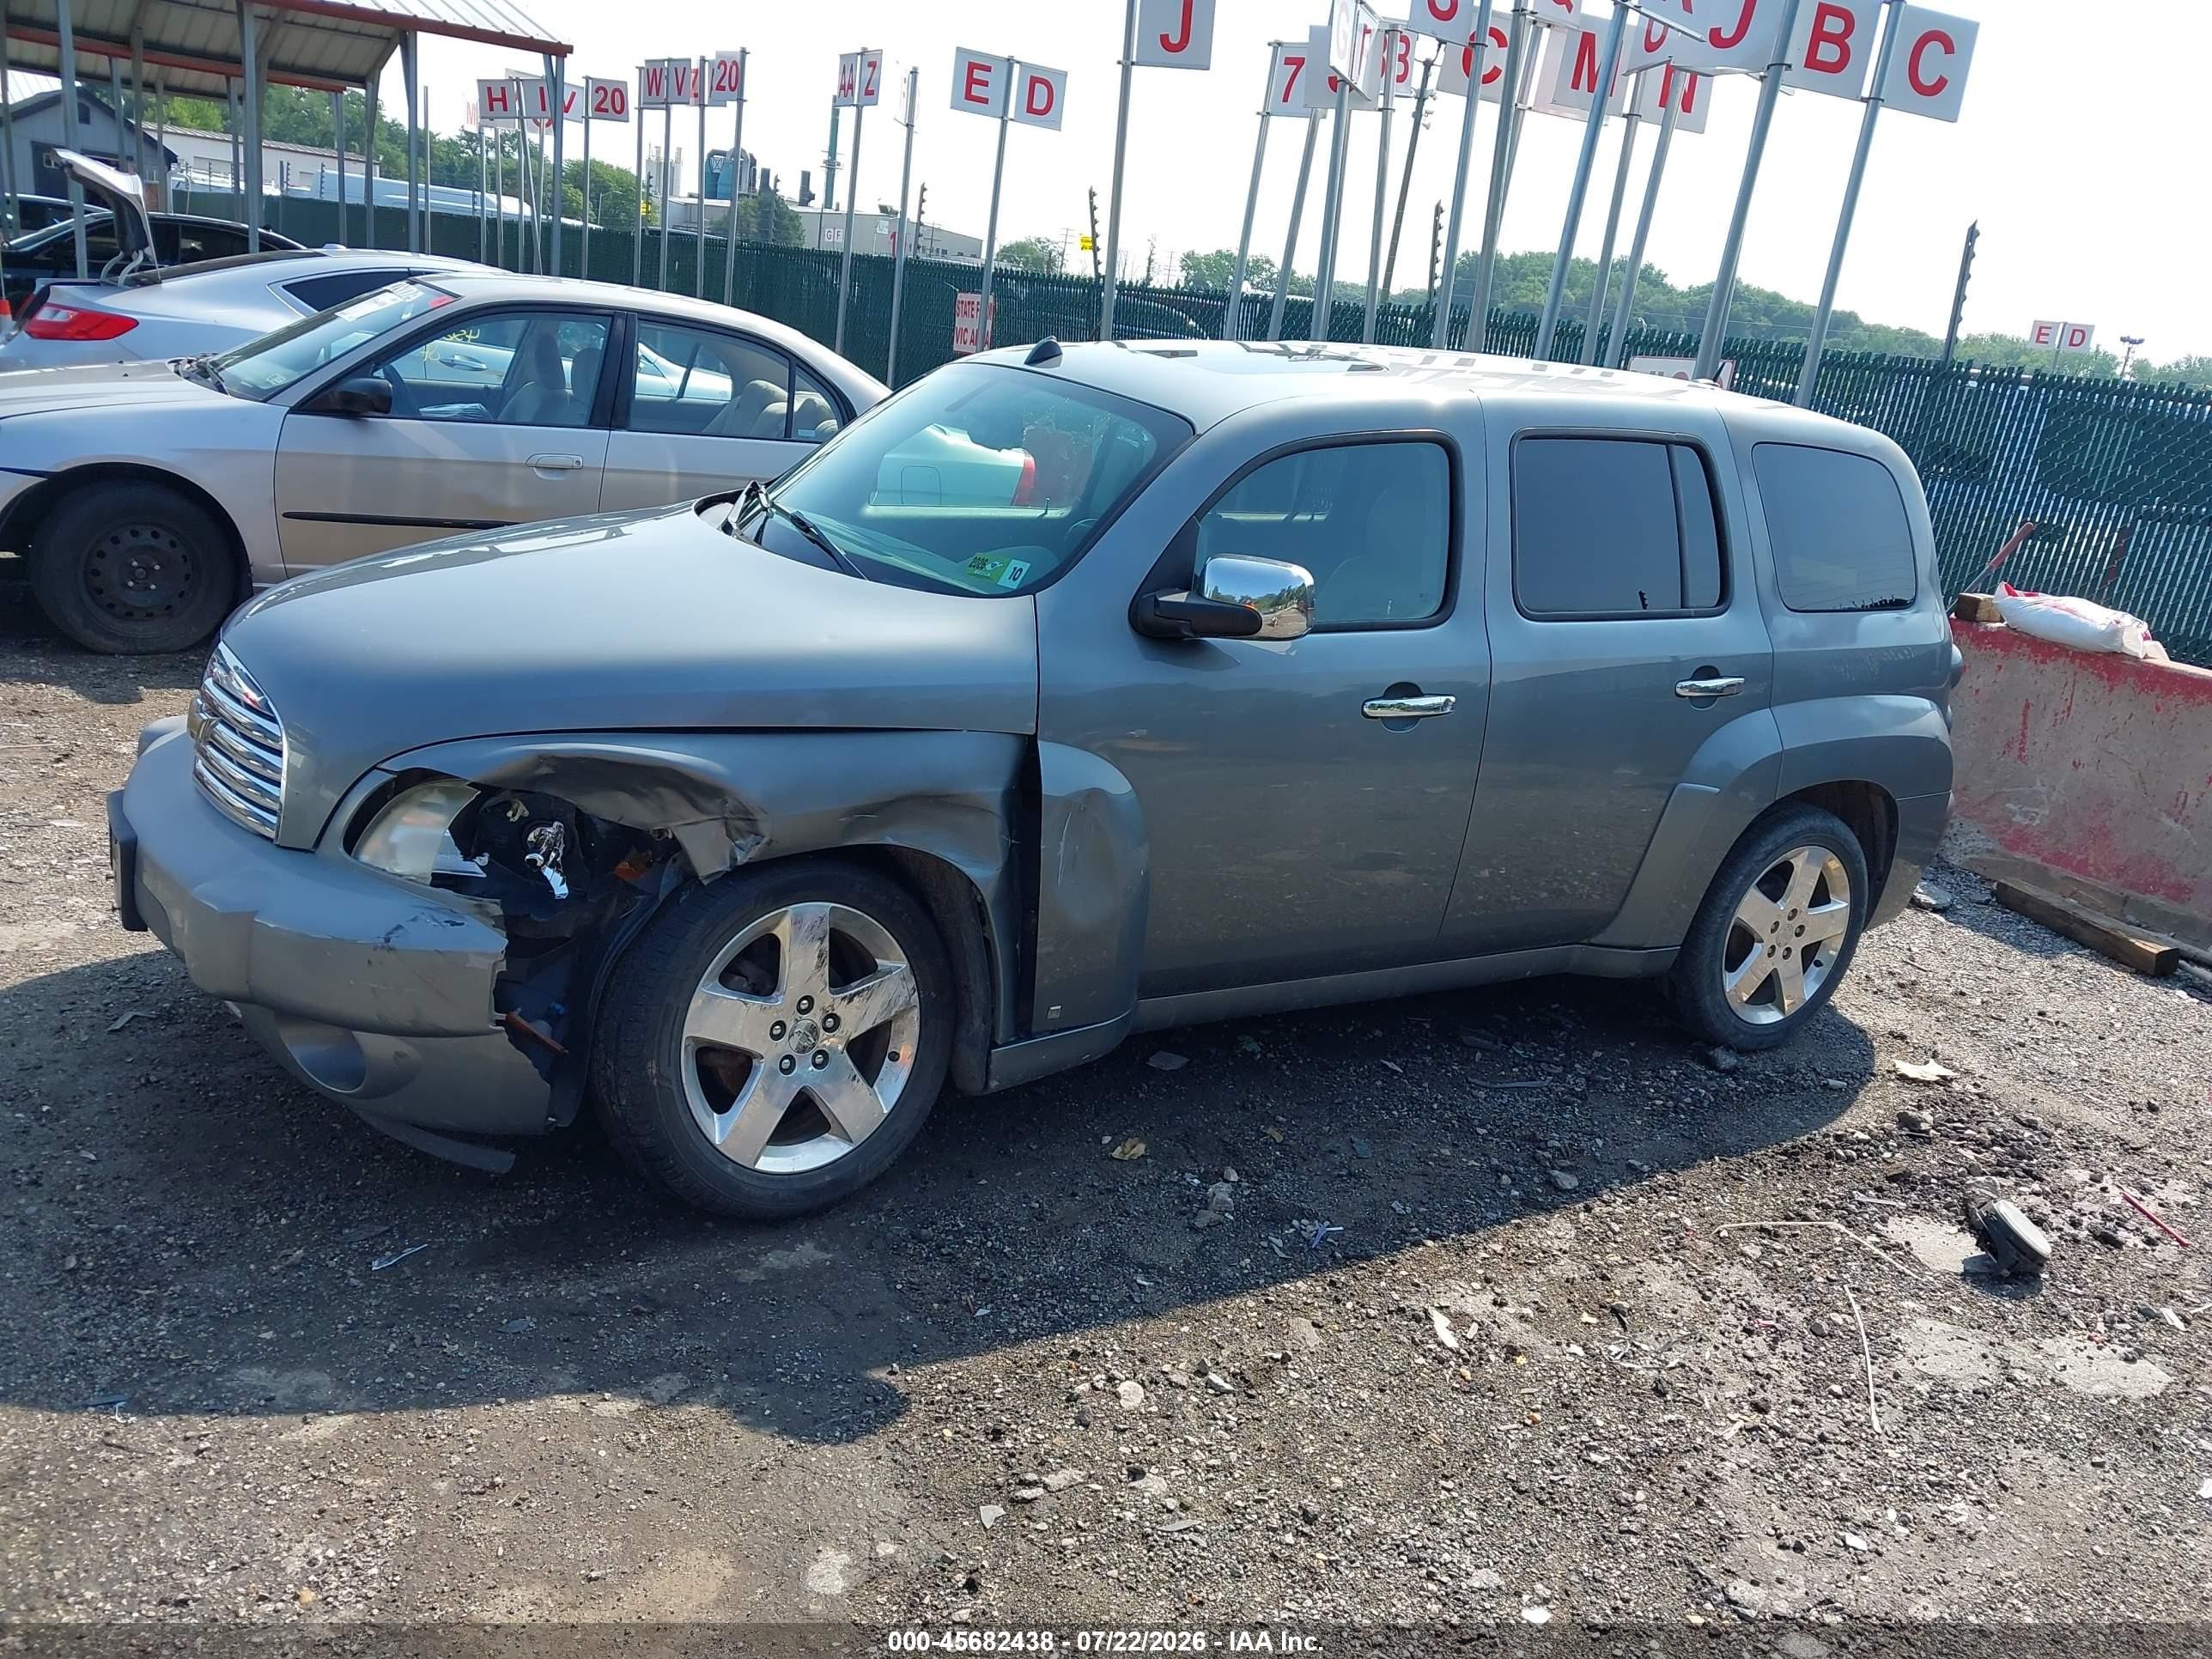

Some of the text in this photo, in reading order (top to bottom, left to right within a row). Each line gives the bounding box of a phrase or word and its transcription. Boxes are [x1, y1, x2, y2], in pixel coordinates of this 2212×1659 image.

[1159, 0, 1194, 53] J
[1708, 0, 1758, 49] J
[1803, 2, 1856, 75] B
[1462, 27, 1508, 84] C
[1571, 31, 1624, 98] M
[1908, 29, 1955, 97] C
[646, 68, 664, 97] W
[674, 66, 687, 96] V
[715, 59, 739, 93] 20
[838, 63, 854, 99] AA
[864, 60, 878, 96] Z
[964, 61, 993, 105] E
[1282, 57, 1306, 103] 7
[486, 86, 508, 112] H
[538, 86, 547, 112] I
[593, 85, 626, 115] 20
[1025, 75, 1054, 116] D
[825, 229, 833, 240] G
[836, 230, 842, 240] F
[956, 299, 975, 319] STATE
[955, 326, 969, 345] VIC
[2035, 325, 2051, 345] E
[2068, 328, 2087, 348] D
[1007, 566, 1024, 582] 10
